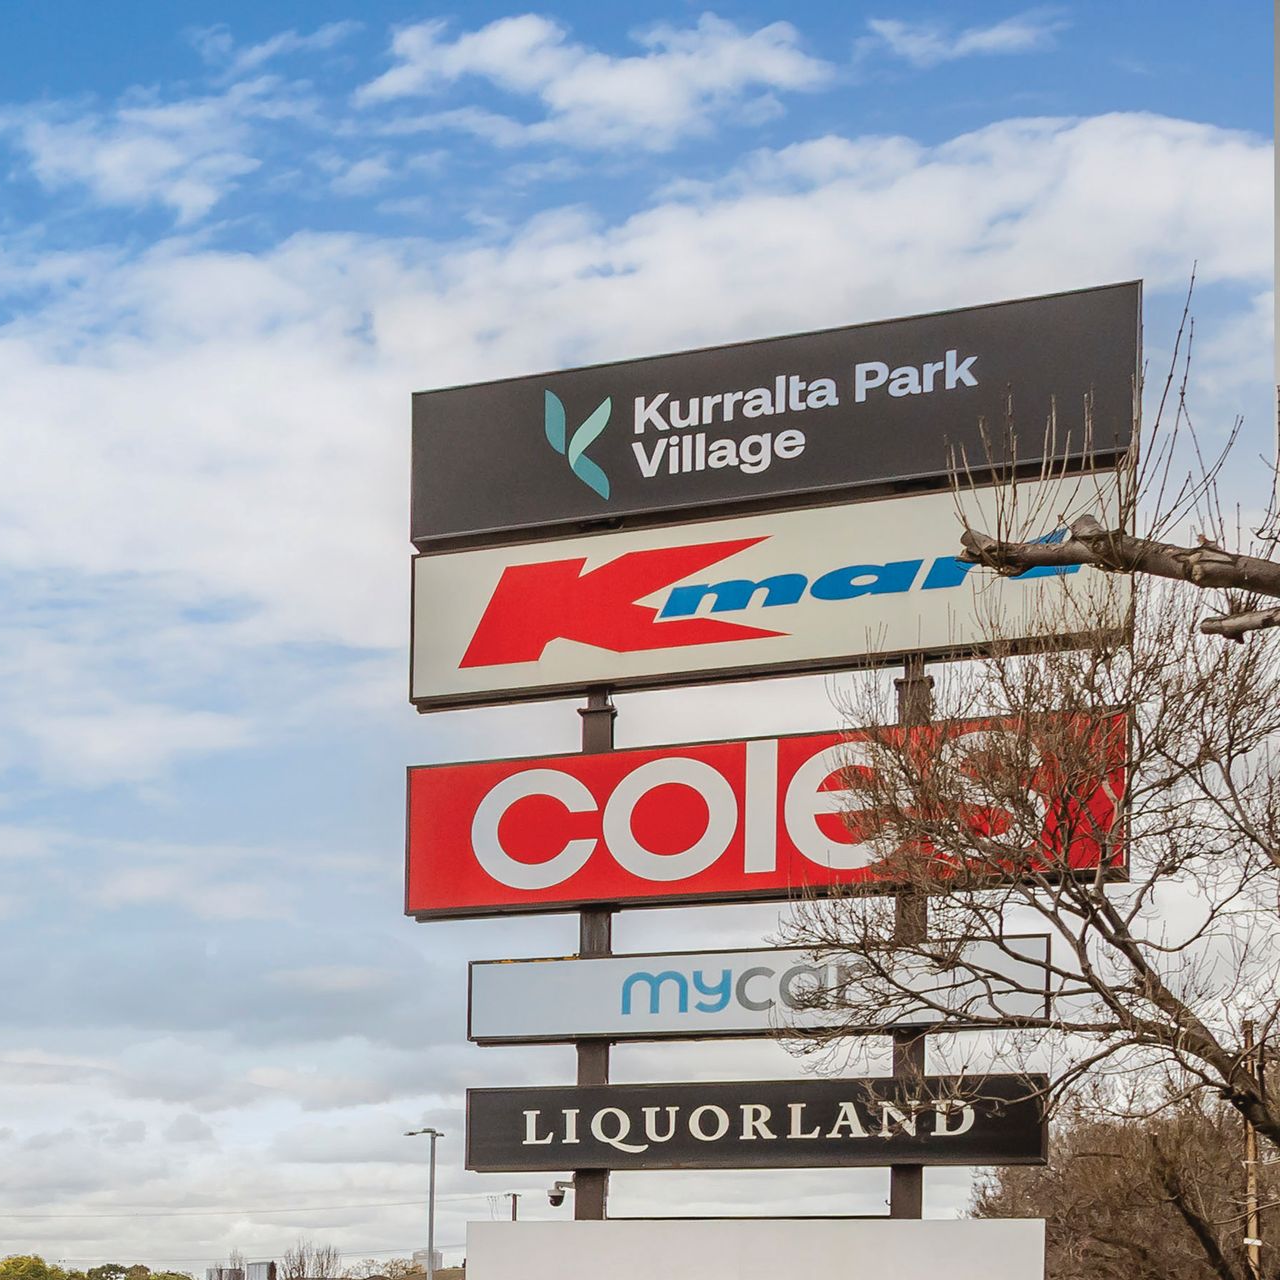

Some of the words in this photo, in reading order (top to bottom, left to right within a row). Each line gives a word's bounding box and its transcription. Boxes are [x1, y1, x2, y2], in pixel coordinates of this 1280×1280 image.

[633, 374, 839, 435] Kurralta
[854, 349, 979, 405] Park
[632, 427, 806, 478] Village
[523, 1099, 977, 1154] LIQUORLAND
